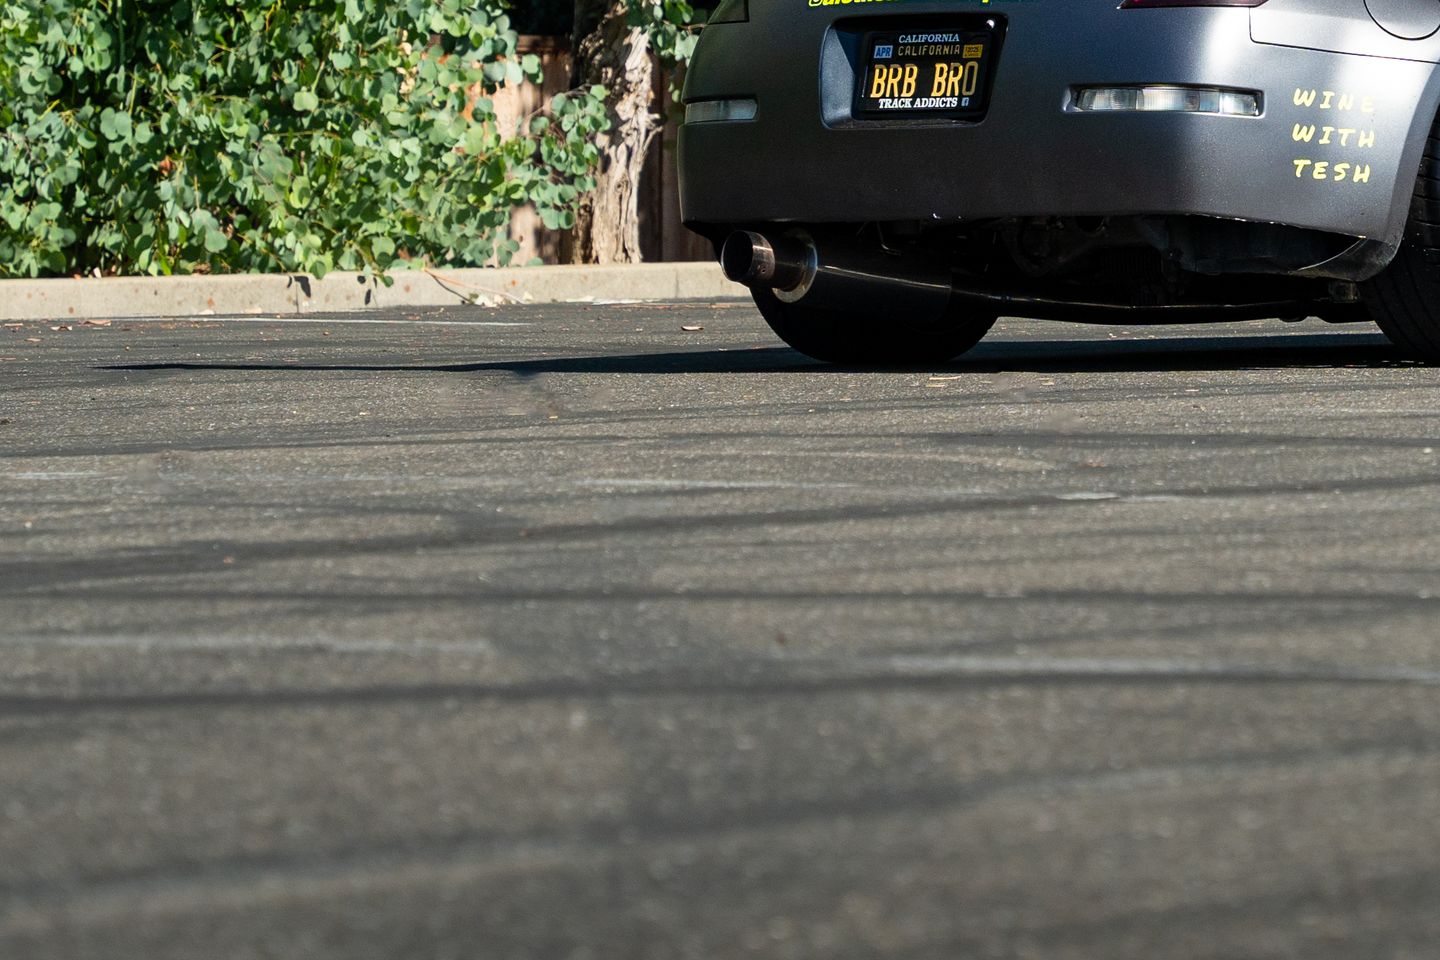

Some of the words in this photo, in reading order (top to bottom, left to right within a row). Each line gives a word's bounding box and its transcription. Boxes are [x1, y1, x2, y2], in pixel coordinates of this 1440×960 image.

[898, 33, 960, 44] CALIFORNIA
[875, 46, 892, 57] APR
[897, 44, 961, 57] CALIFORNIA
[870, 63, 919, 98] BRB
[930, 61, 979, 97] BRO
[878, 98, 912, 109] TRACK
[912, 97, 958, 109] ADDICTS
[1292, 87, 1376, 113] WINE
[1291, 123, 1375, 148] WITH
[1292, 158, 1371, 183] TESH
